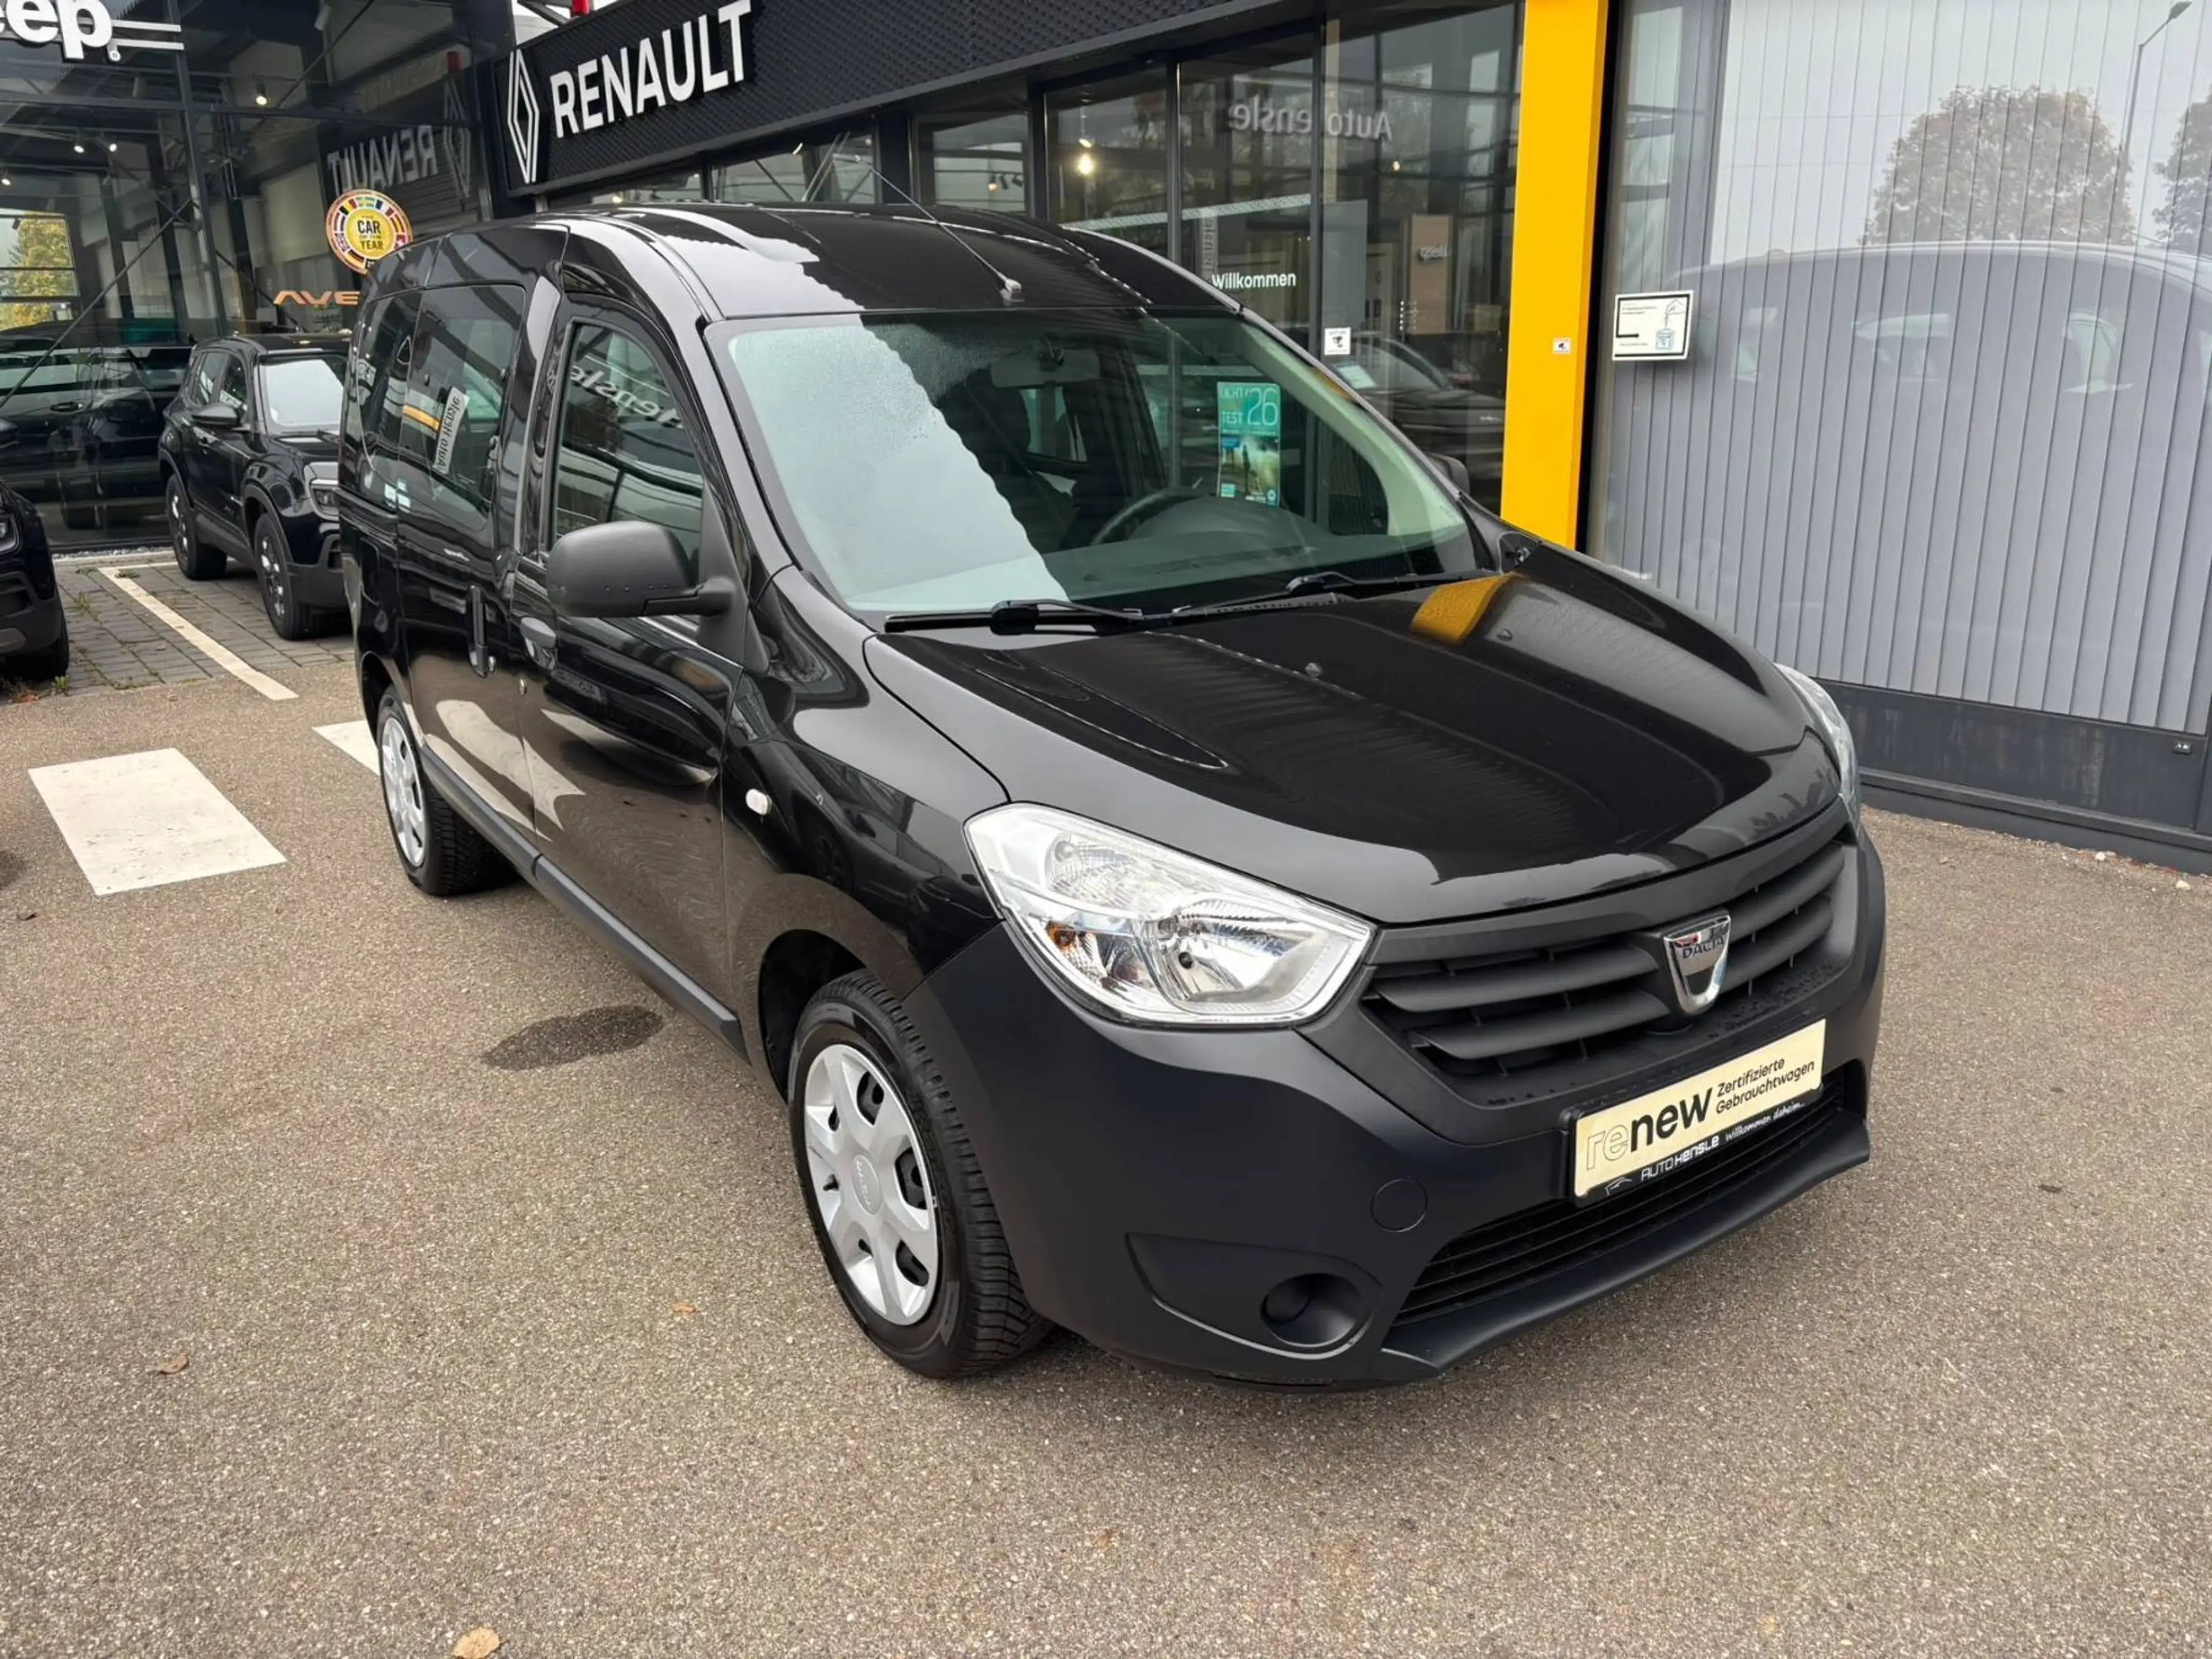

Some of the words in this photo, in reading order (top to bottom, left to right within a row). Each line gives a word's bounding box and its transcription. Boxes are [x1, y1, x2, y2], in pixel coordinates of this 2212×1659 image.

[550, 0, 752, 138] RENAULT
[357, 220, 381, 234] CAR
[360, 240, 384, 250] YEAR
[1211, 271, 1297, 290] Willkommen
[1221, 411, 1243, 425] TEST
[1683, 934, 1724, 959] DACIA
[1716, 1060, 1815, 1115] Gebrauchtwagen
[1717, 1058, 1785, 1097] Zertifizierte
[1586, 1088, 1713, 1171] renew
